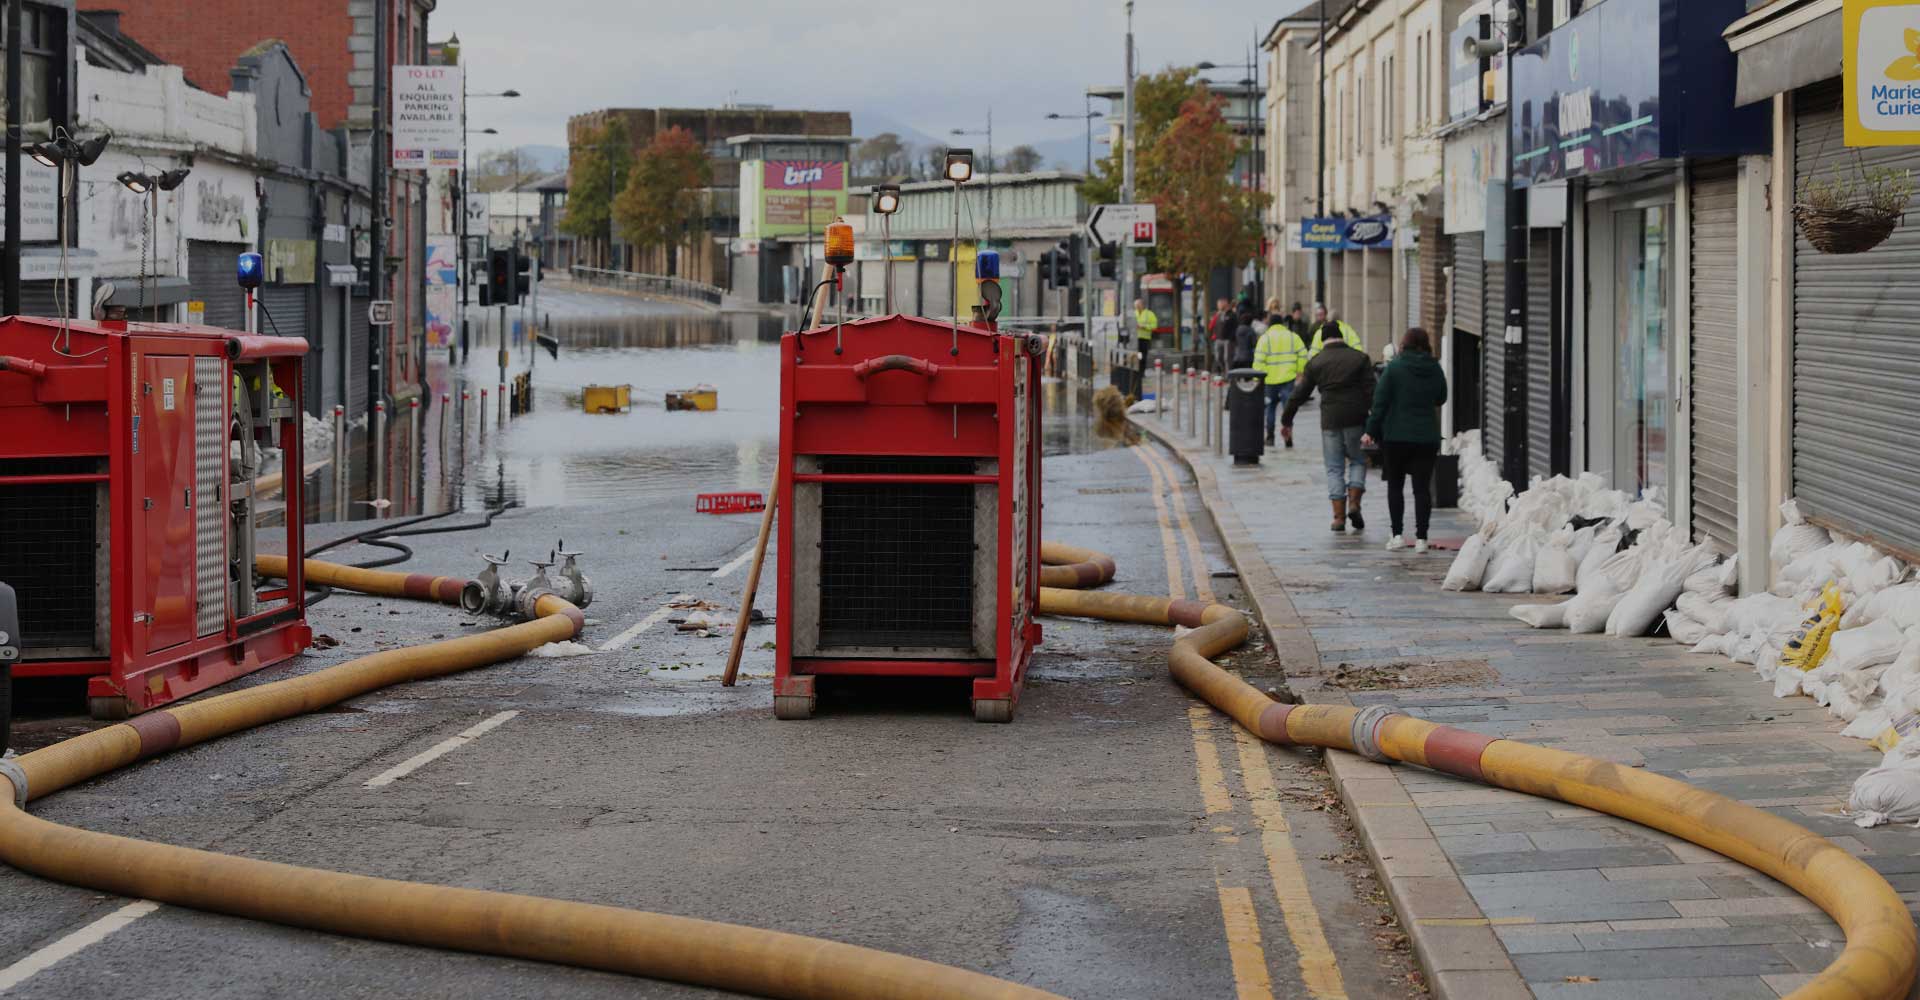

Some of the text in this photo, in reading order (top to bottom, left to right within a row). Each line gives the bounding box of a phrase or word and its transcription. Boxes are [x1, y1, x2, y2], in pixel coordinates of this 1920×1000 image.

[408, 70, 445, 78] TO LET
[399, 93, 454, 102] ENQUIRIES
[1871, 84, 1920, 100] Marie
[404, 103, 449, 111] PARKING
[1876, 100, 1920, 116] Curie
[1136, 223, 1150, 237] H
